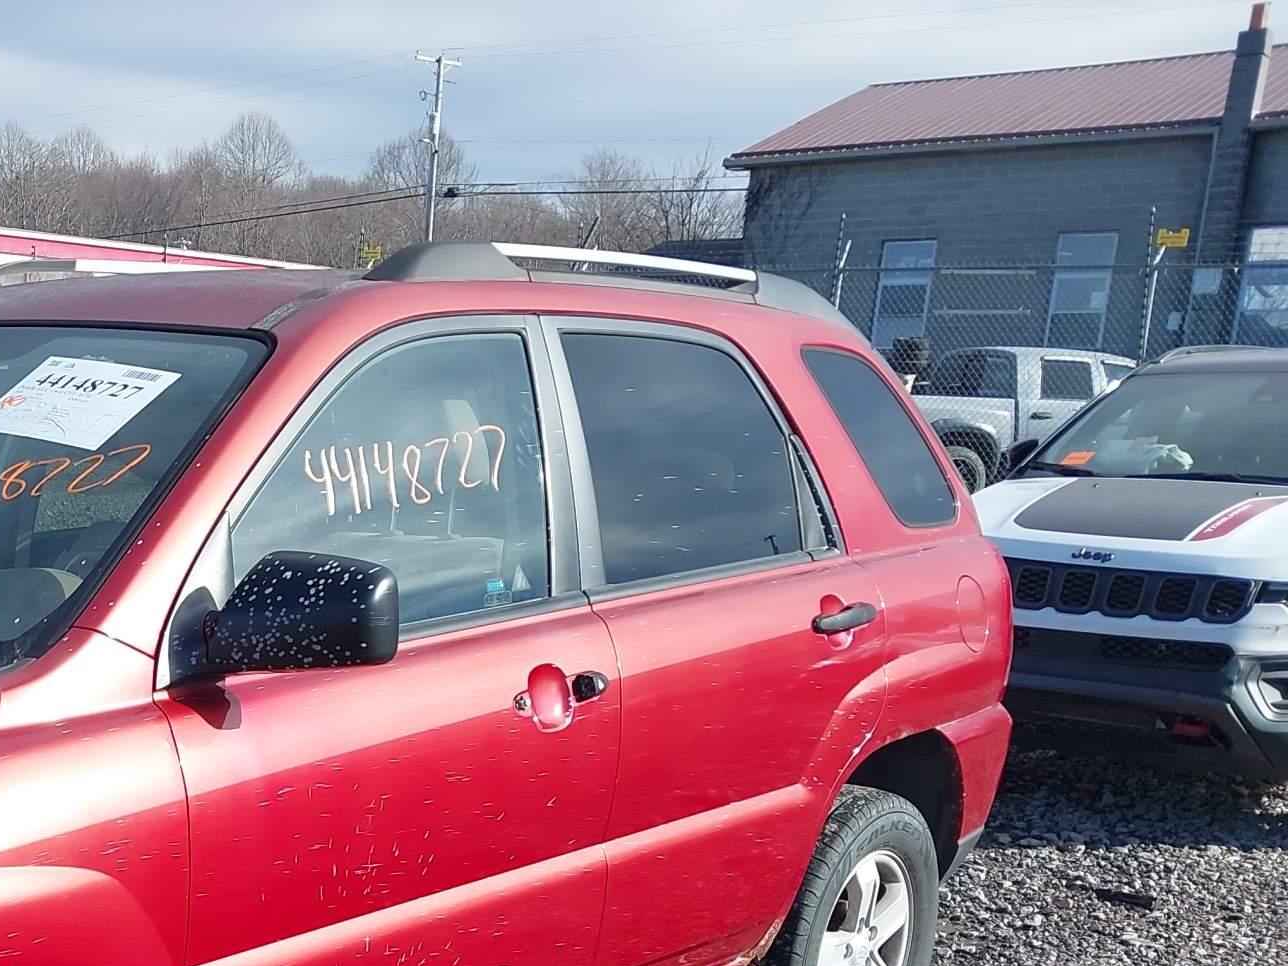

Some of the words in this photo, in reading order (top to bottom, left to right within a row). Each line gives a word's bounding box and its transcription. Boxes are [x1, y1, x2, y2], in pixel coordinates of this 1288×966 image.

[36, 373, 145, 399] 44148727
[304, 425, 506, 516] 44148727
[1071, 547, 1115, 563] Jeep
